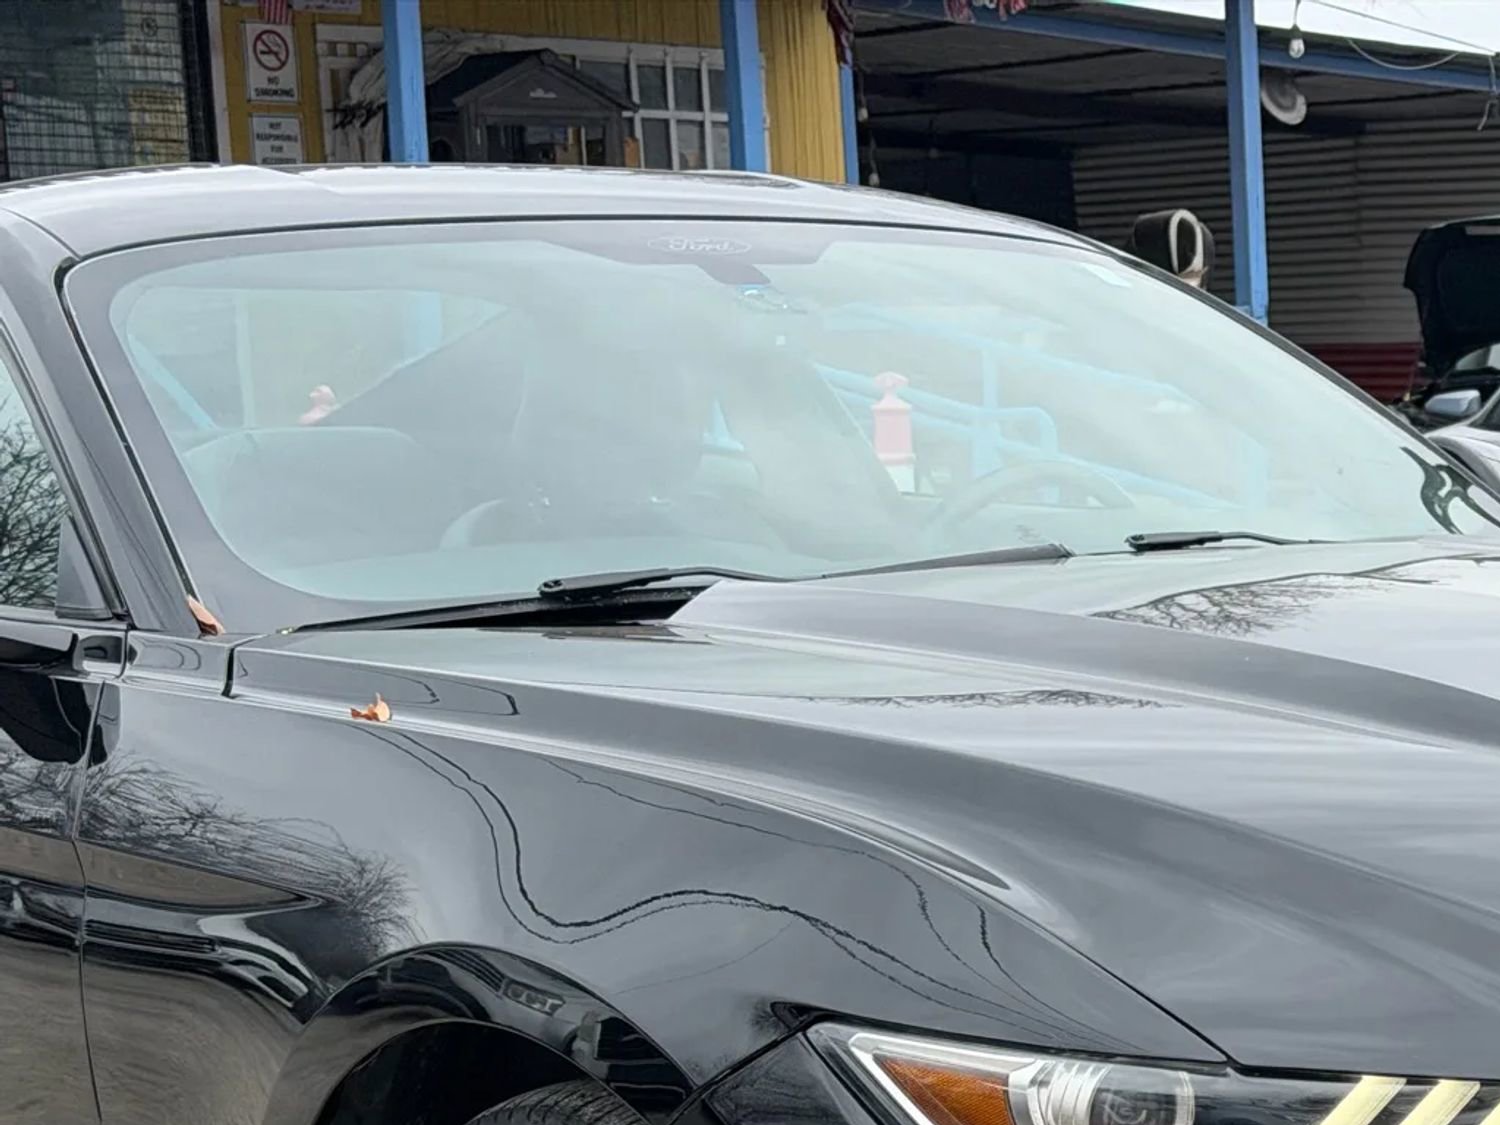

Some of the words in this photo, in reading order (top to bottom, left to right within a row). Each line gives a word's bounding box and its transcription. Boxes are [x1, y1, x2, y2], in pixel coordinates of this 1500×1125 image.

[267, 76, 280, 86] NO
[254, 88, 295, 97] SMOKING
[668, 238, 735, 252] Ford
